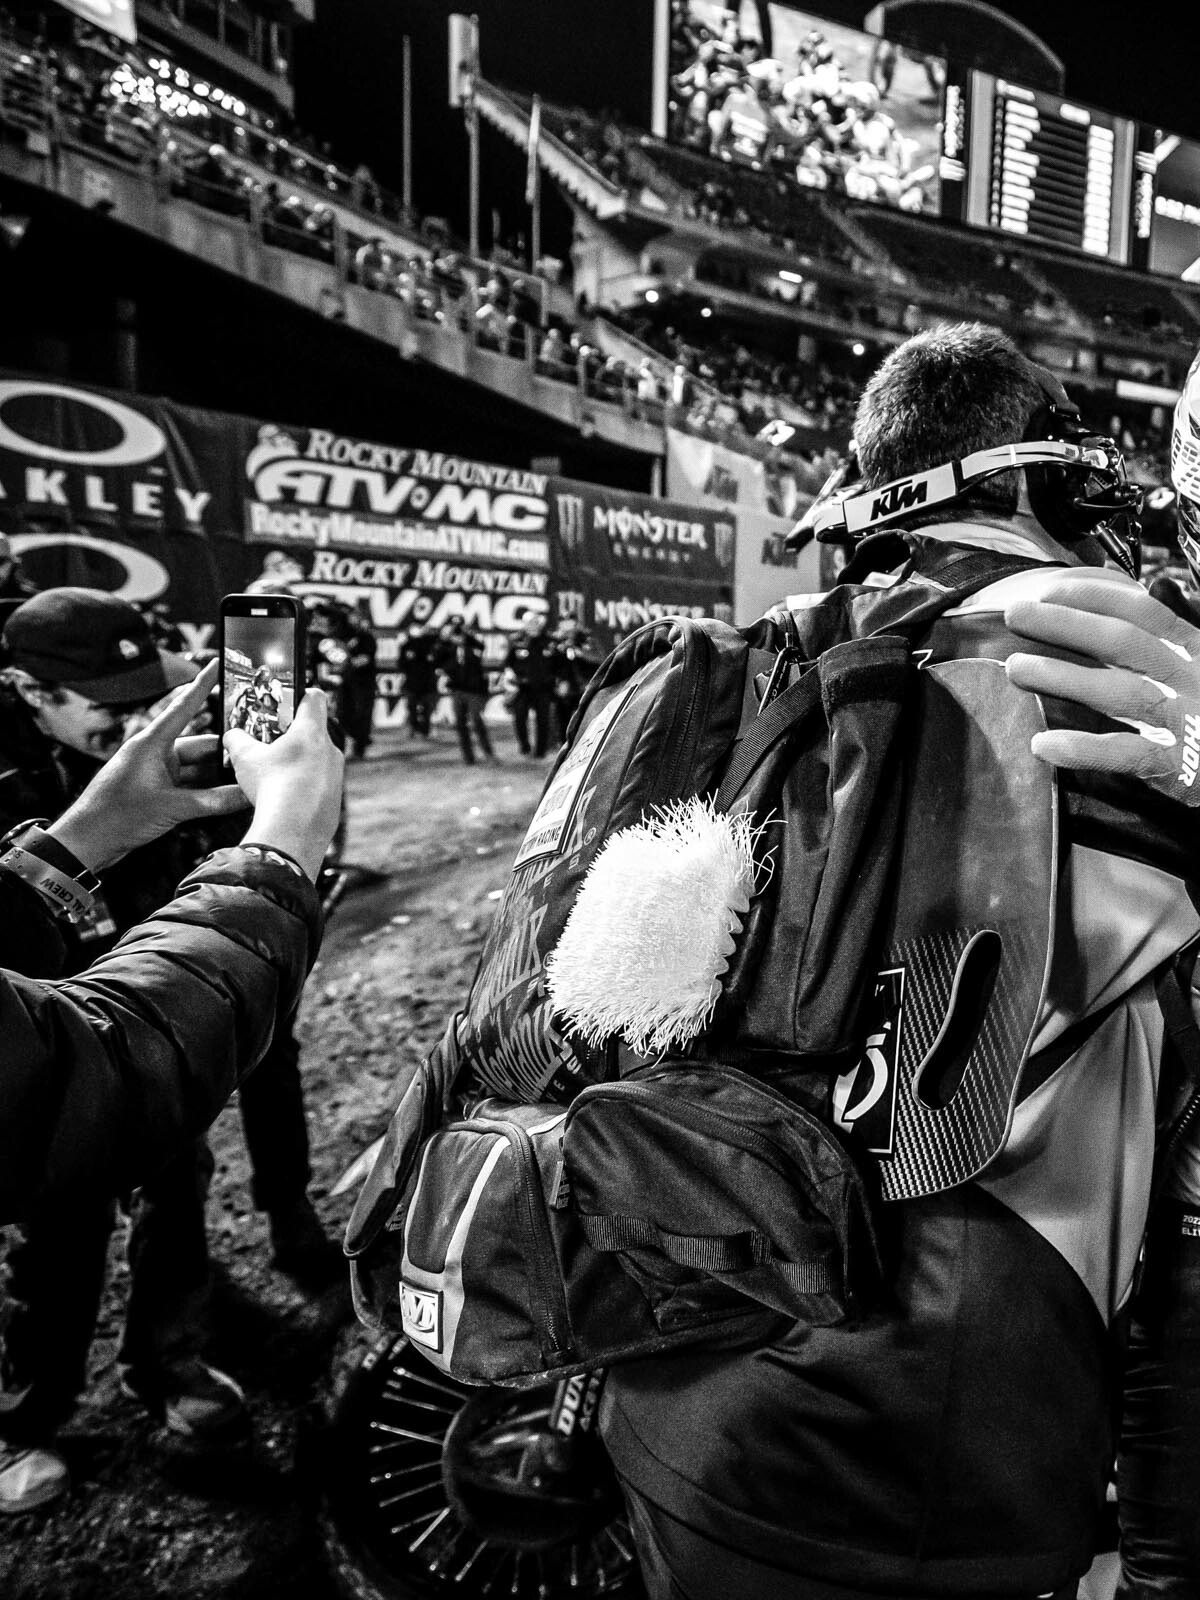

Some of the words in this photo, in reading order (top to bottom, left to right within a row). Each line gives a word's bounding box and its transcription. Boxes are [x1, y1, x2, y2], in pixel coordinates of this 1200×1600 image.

[304, 428, 408, 473] ROCKY
[408, 448, 548, 495] MOUNTAIN
[0, 466, 212, 523] KLEY
[870, 479, 928, 521] KTM
[593, 505, 708, 550] MONSTER
[308, 550, 411, 587] ROCKY
[411, 559, 548, 595] MOUNTAIN
[39, 878, 75, 903] CREW
